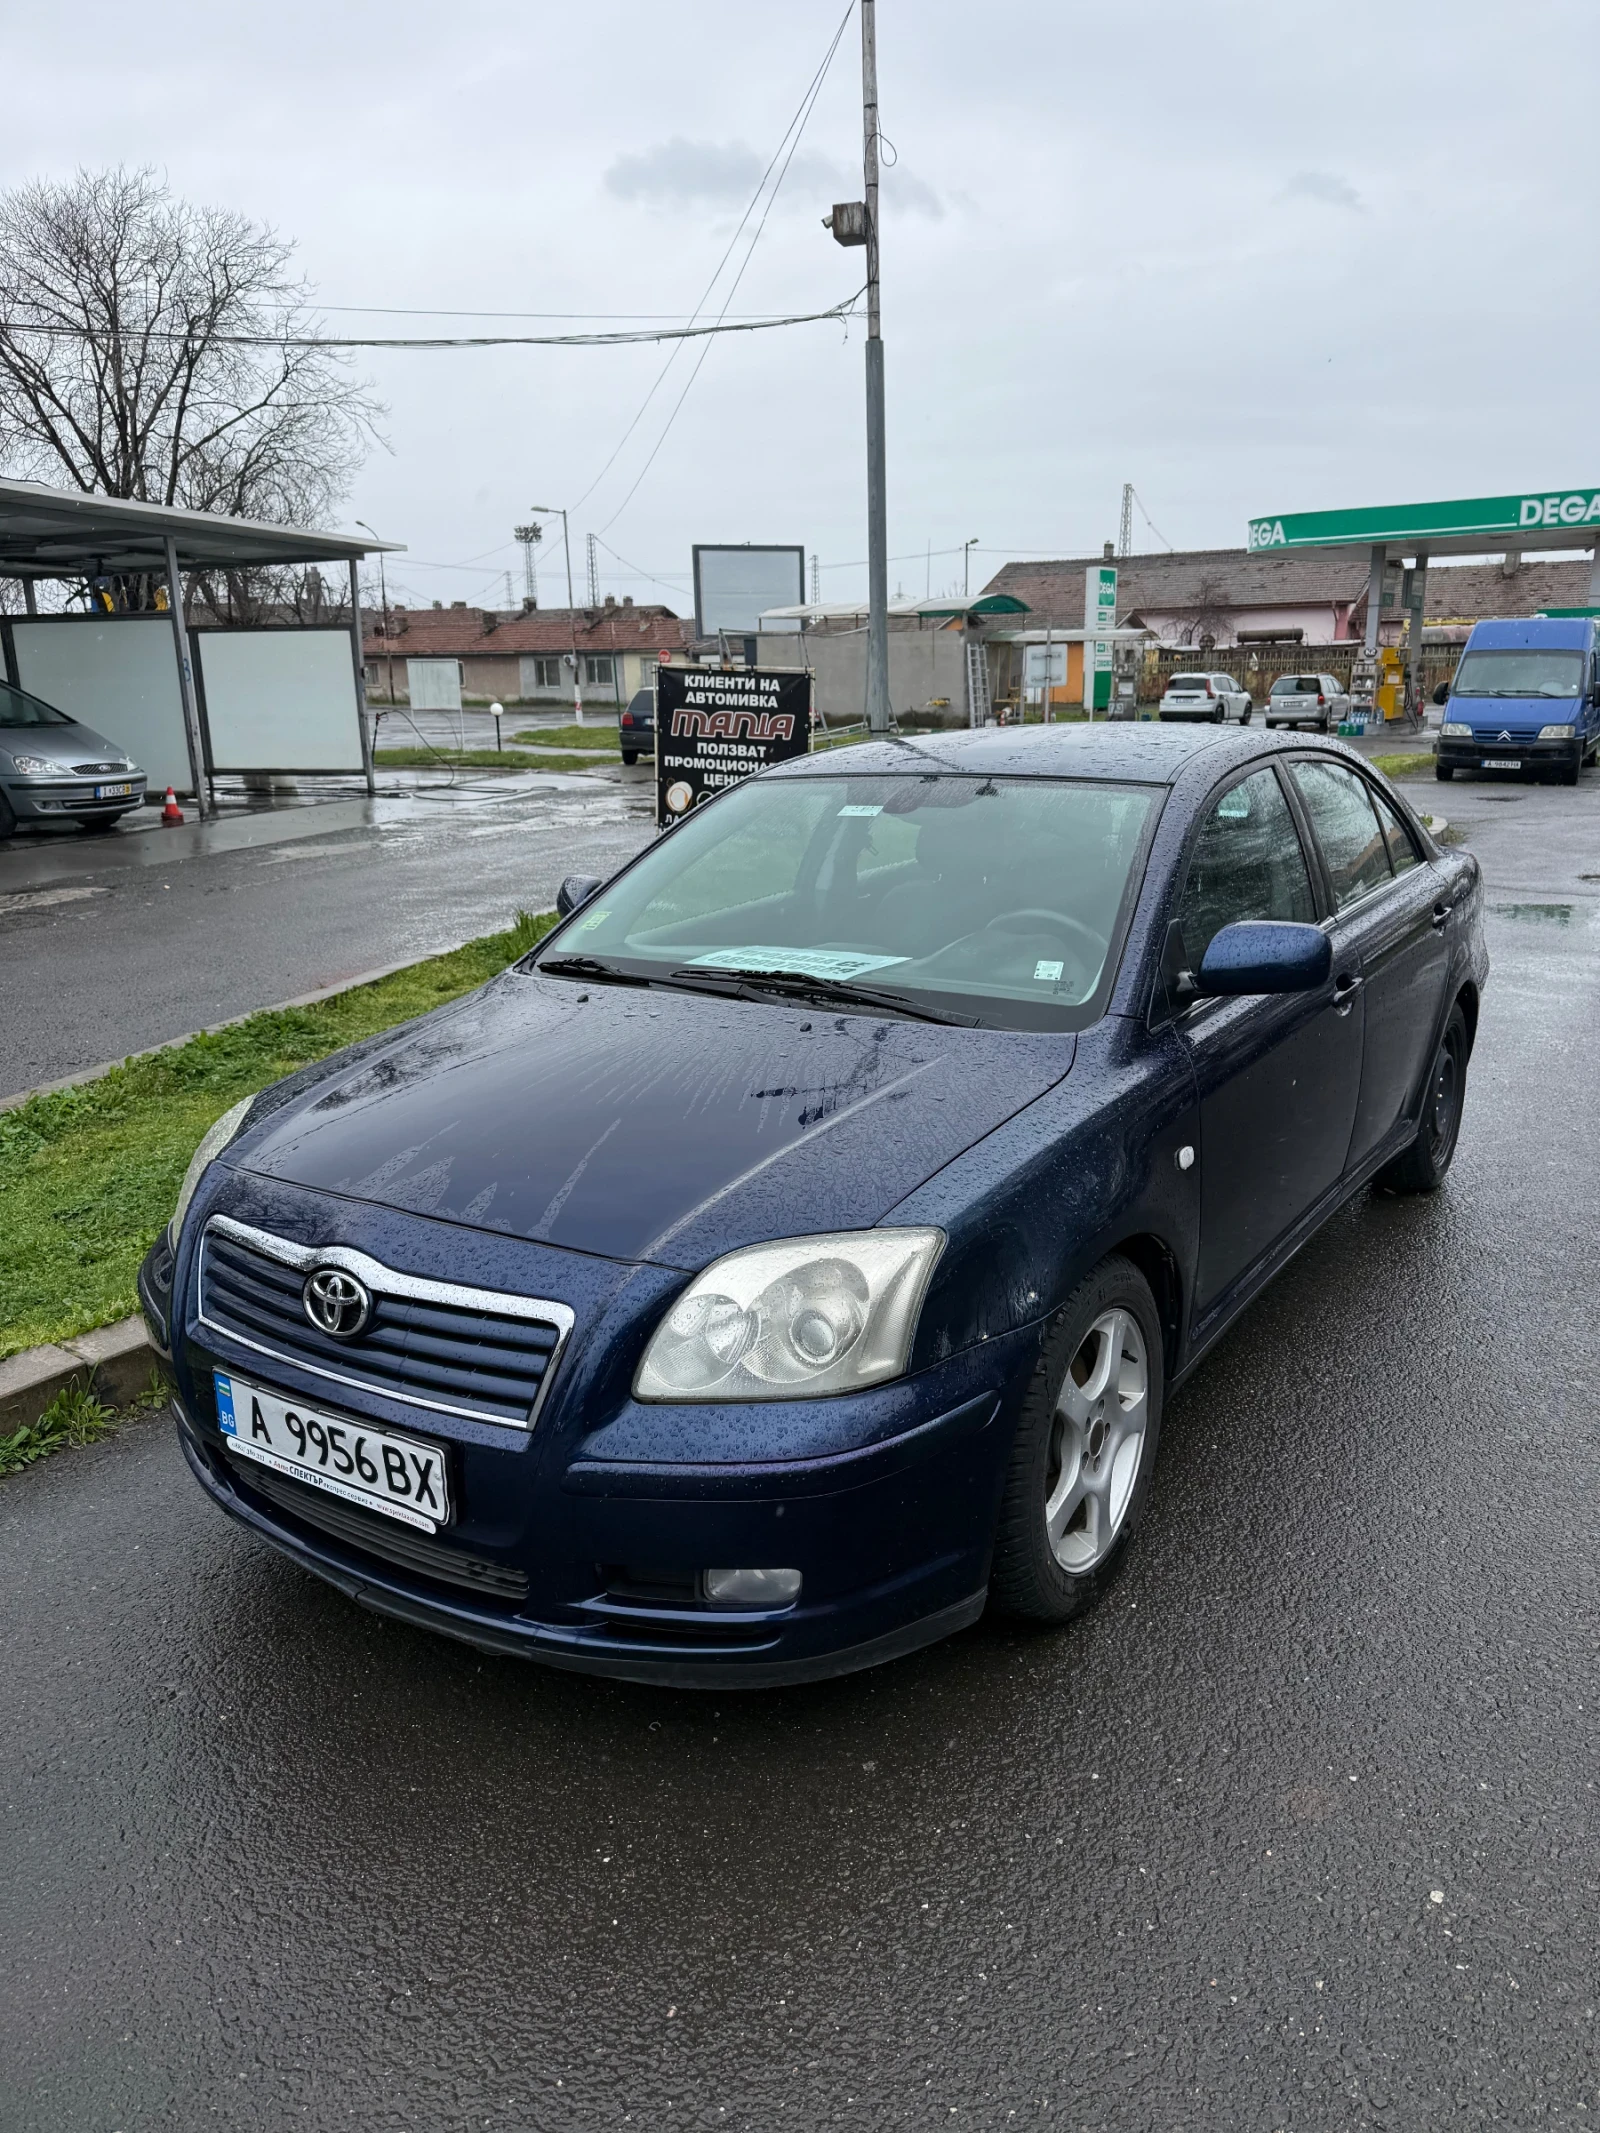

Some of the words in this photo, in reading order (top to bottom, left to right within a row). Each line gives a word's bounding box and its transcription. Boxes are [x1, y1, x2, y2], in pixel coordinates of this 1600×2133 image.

[1519, 494, 1600, 526] DEGA
[684, 674, 756, 691] КЛИЕНТИ
[759, 678, 781, 692] НА
[685, 691, 779, 708] АВТОМИВКА
[697, 742, 767, 759] ПОЛЗВАТ
[221, 1410, 235, 1428] BG
[251, 1396, 273, 1445] A
[289, 1466, 323, 1486] СПЕКТЪР
